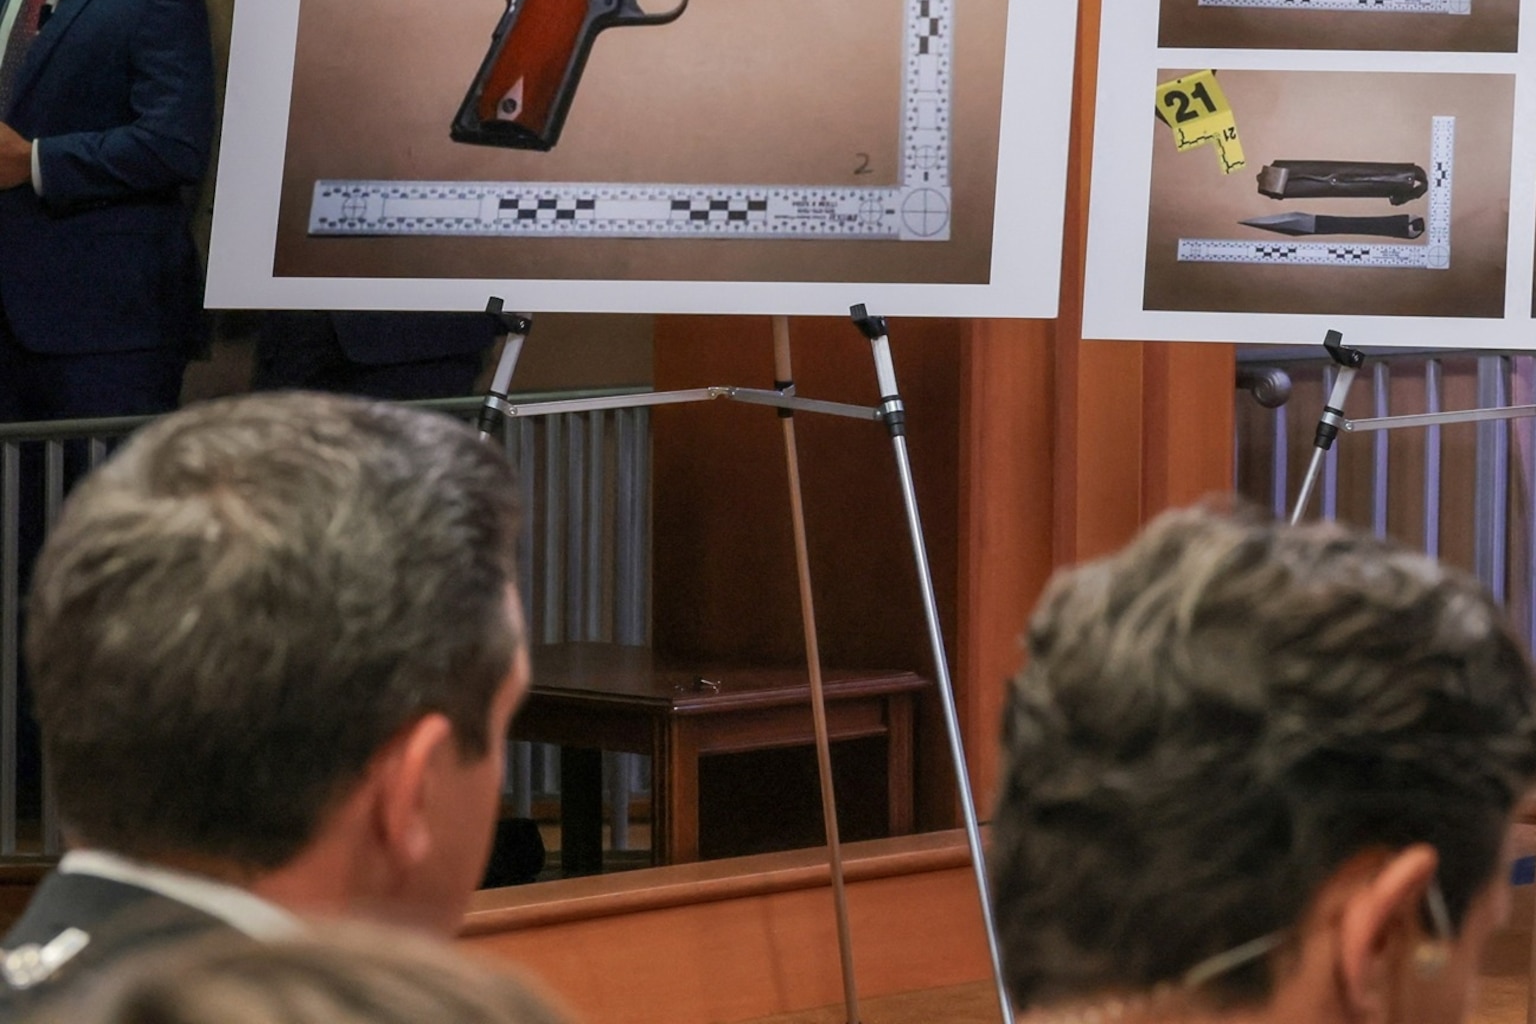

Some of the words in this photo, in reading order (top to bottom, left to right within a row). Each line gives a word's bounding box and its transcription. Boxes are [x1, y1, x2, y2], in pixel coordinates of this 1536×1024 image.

[1164, 81, 1217, 123] 21
[1222, 126, 1237, 142] 21
[853, 152, 874, 175] 2
